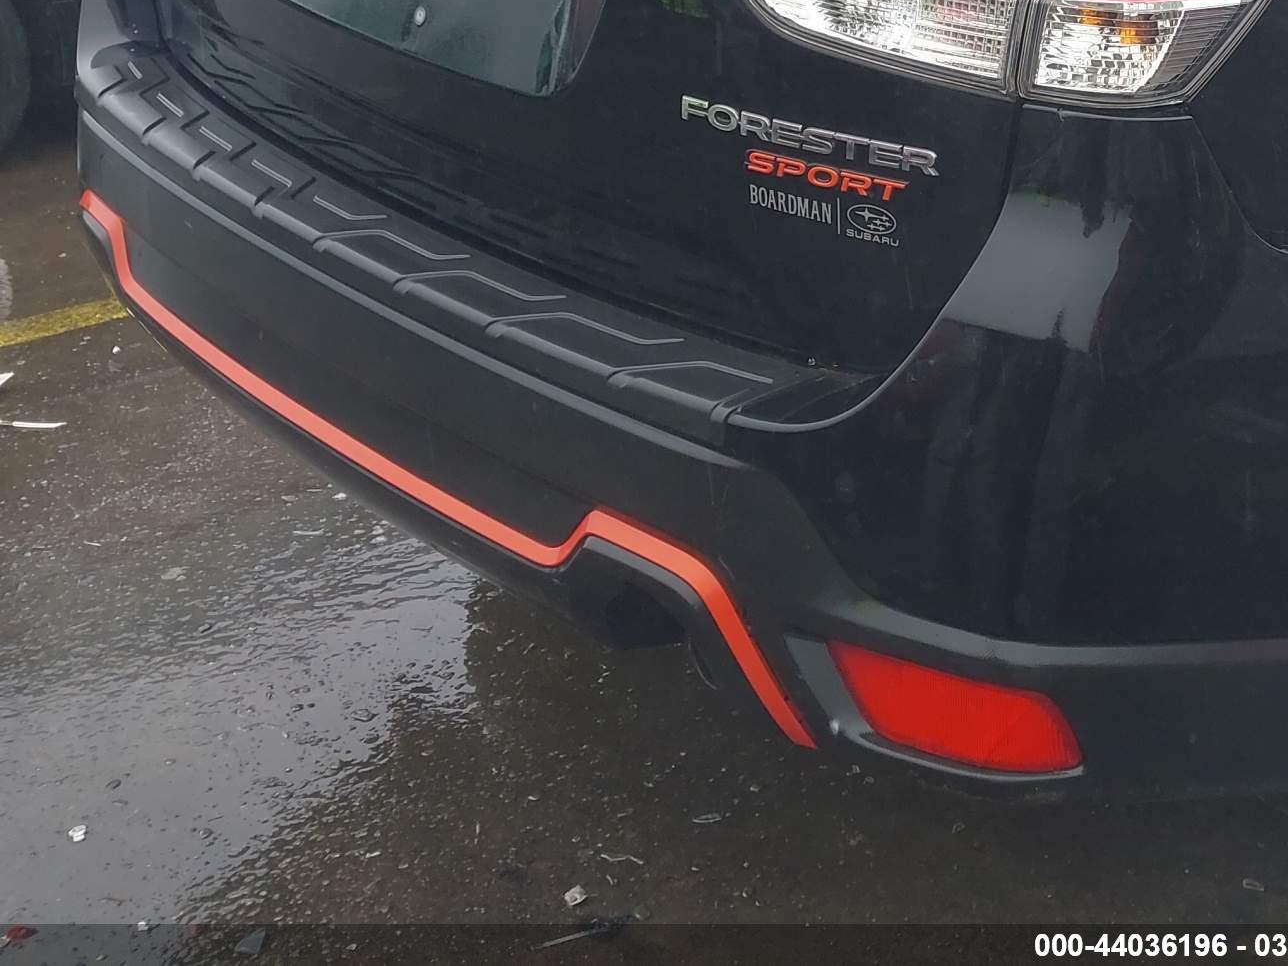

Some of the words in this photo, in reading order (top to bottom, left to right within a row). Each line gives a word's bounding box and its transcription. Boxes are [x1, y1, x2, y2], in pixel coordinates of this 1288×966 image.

[681, 94, 939, 176] FORESTER
[745, 149, 909, 201] SPORT
[748, 183, 832, 225] BOARDMAN
[845, 228, 899, 247] SUBARU
